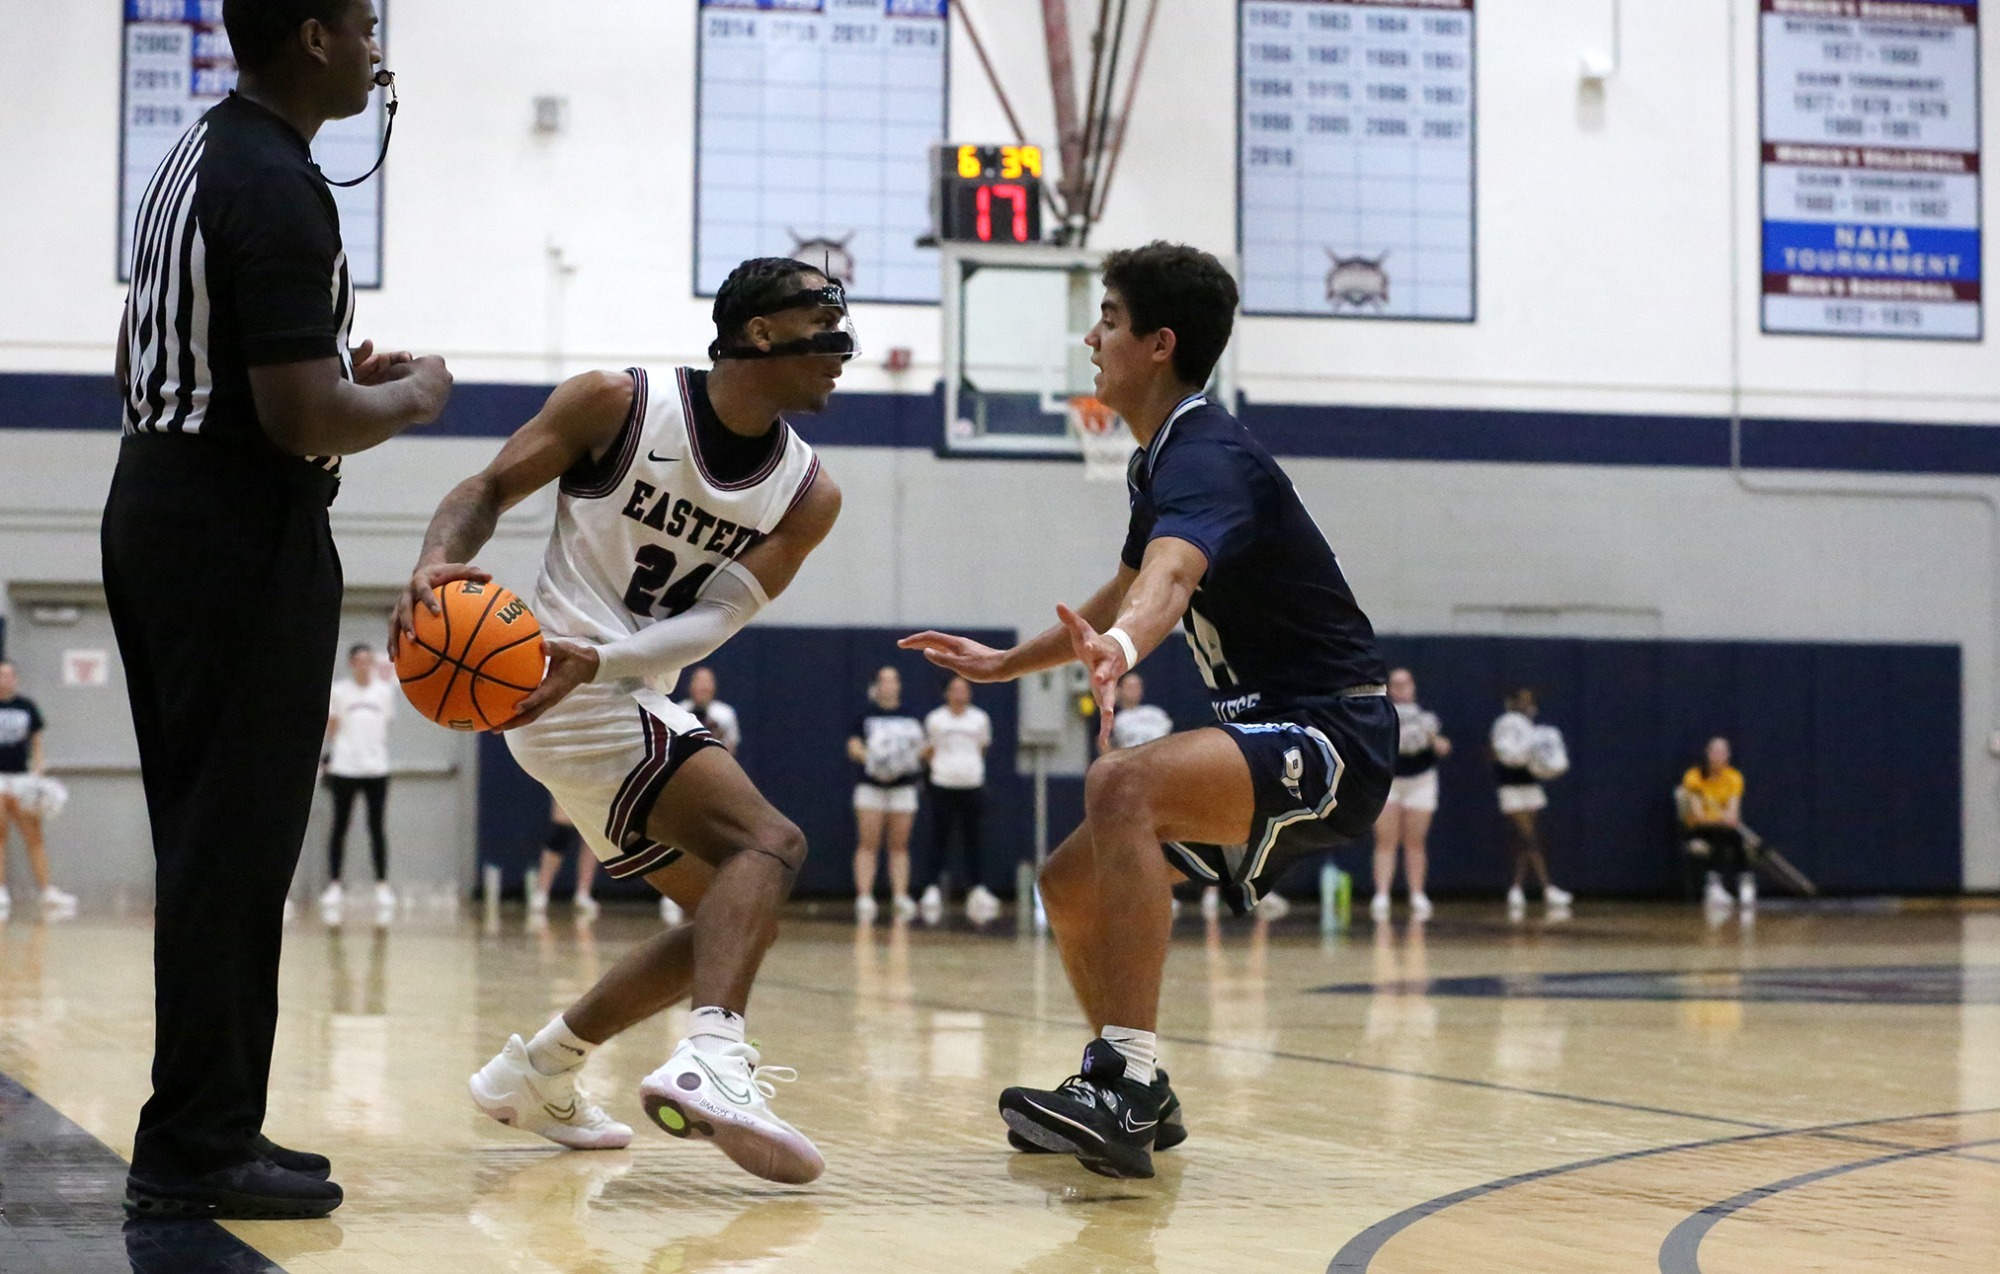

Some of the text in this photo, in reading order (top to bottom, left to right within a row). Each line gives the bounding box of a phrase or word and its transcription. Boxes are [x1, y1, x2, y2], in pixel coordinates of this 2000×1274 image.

[976, 184, 1028, 242] 17
[1834, 226, 1910, 250] NAIA
[1784, 247, 1960, 276] TOURNAMENT
[622, 543, 718, 619] 24
